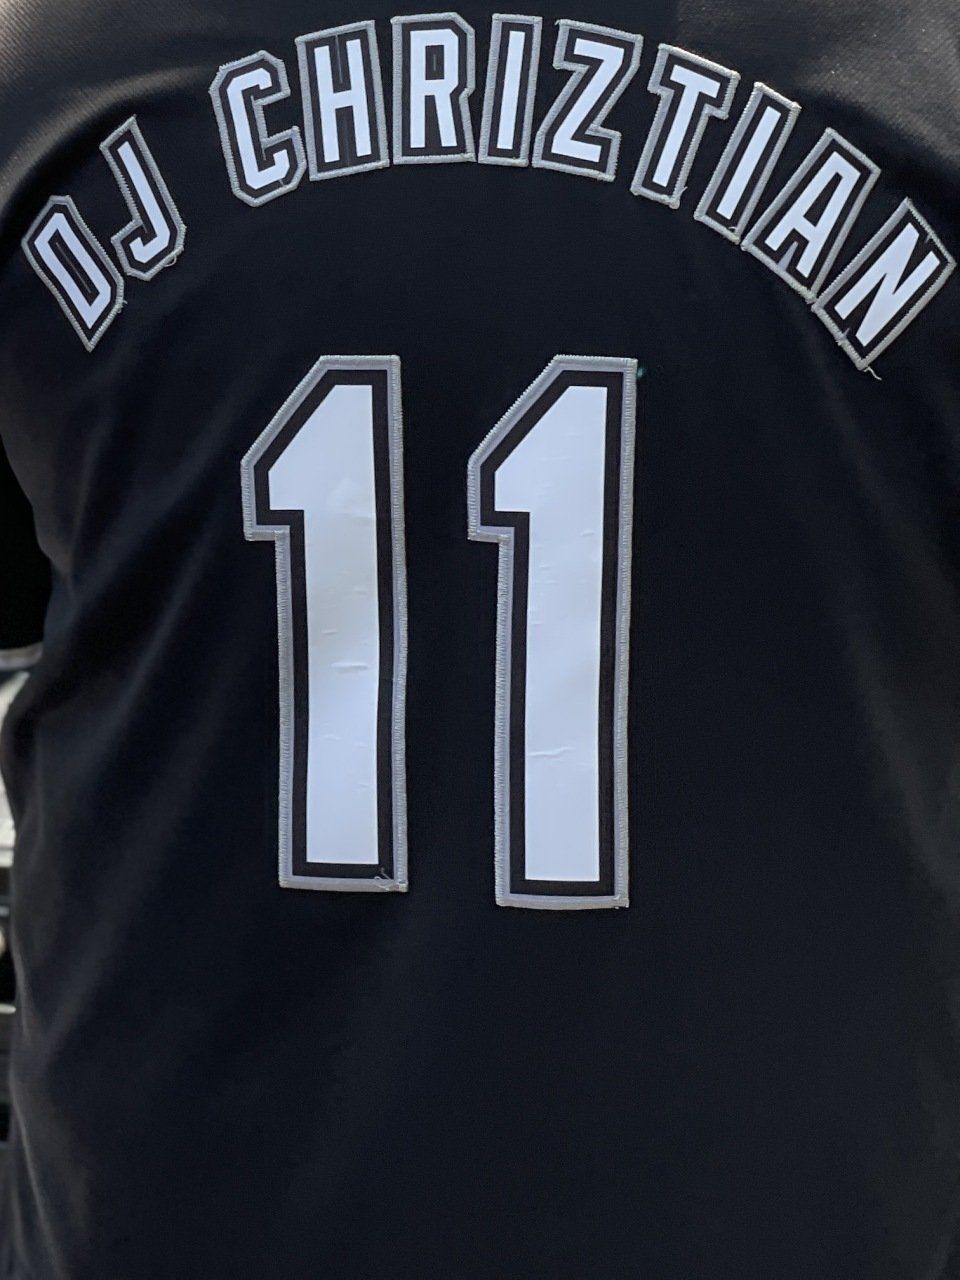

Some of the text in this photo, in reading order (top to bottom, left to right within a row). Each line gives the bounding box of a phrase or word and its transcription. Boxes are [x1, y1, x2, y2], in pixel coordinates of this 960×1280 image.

[23, 13, 956, 371] DJ CHRIZTIAN
[241, 354, 639, 909] 11
